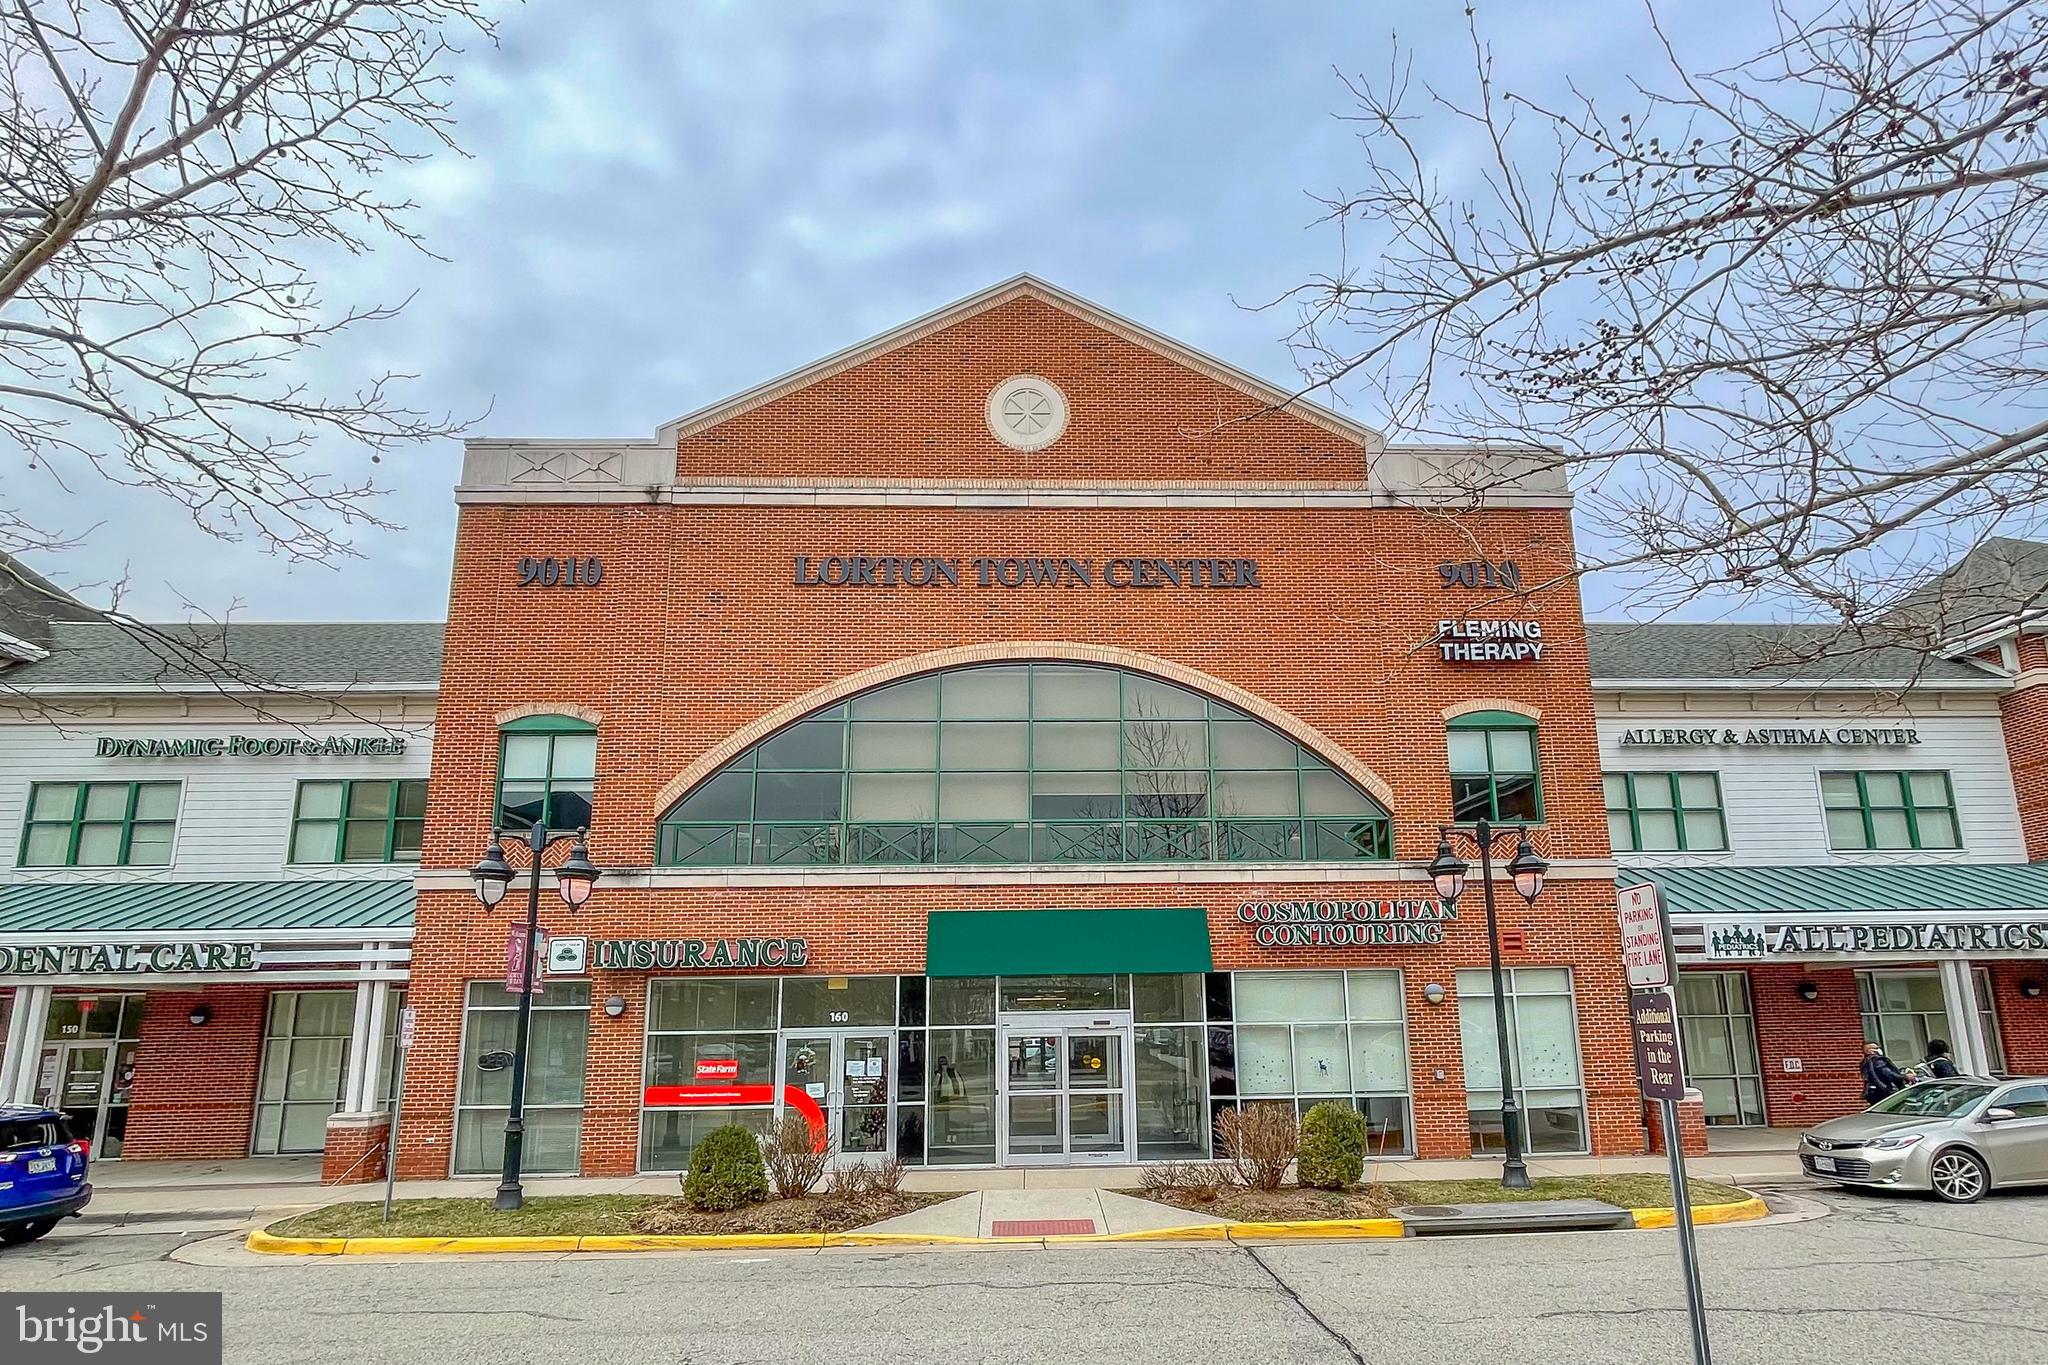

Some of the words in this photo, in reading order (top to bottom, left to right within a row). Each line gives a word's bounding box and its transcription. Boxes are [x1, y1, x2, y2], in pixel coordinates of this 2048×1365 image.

[517, 556, 602, 587] 9010
[794, 557, 958, 587] LORTON
[973, 558, 1092, 588] TOWN
[1104, 558, 1261, 588] CENTER
[1438, 620, 1542, 639] FLEMING
[1440, 643, 1543, 661] THERAPY
[1622, 728, 1717, 745] ALLERGY
[1723, 729, 1739, 744] &
[1744, 728, 1832, 745] ASTHMA
[1836, 728, 1922, 744] CENTER
[95, 736, 223, 757] DYNAMIC
[227, 735, 302, 757] FOOT
[301, 741, 323, 757] &
[323, 735, 406, 756] ANKLE
[1631, 892, 1642, 906] NO
[1237, 899, 1459, 922] COSMOPOLITAN
[1624, 907, 1654, 924] PARKING
[1256, 922, 1444, 945] CONTOURING
[1626, 933, 1660, 949] STANDING
[1730, 935, 1744, 944] ALL
[1776, 924, 1848, 951] ALL
[1851, 924, 2044, 950] PEDIATRICS
[150, 943, 256, 972] CARE
[593, 938, 808, 968] INSURANCE
[1628, 952, 1643, 967] FIRE
[1644, 949, 1662, 966] LANE
[829, 1011, 849, 1023] 160
[1636, 1007, 1672, 1024] Additional
[61, 1024, 79, 1034] 150
[1639, 1030, 1674, 1046] Parking
[1647, 1047, 1656, 1063] in
[1656, 1047, 1672, 1064] the
[696, 1065, 716, 1073] State
[717, 1065, 738, 1073] Farm
[1650, 1068, 1673, 1085] Rear
